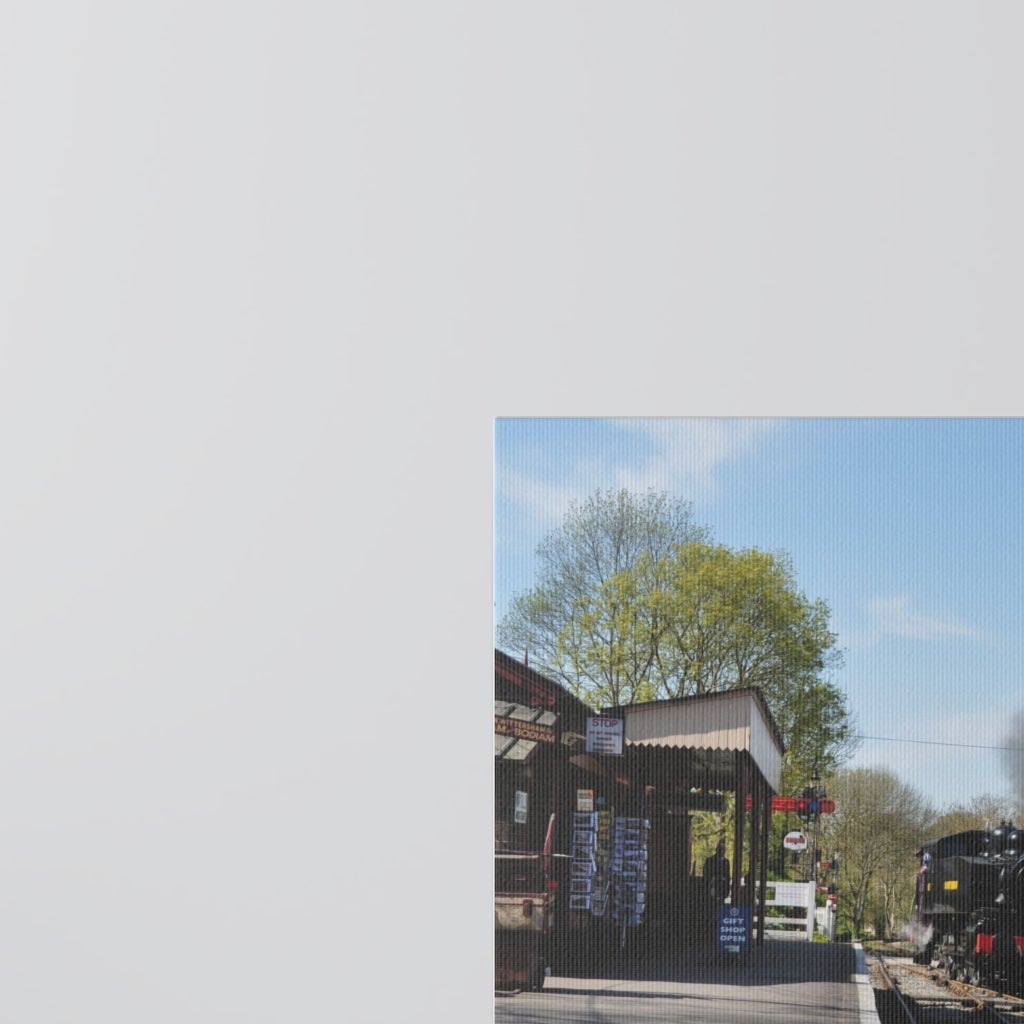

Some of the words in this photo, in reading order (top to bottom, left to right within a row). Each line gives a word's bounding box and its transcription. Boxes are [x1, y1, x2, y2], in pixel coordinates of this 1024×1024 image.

[592, 718, 618, 728] STOP
[514, 728, 555, 743] BODIAM
[723, 917, 744, 925] GIFT
